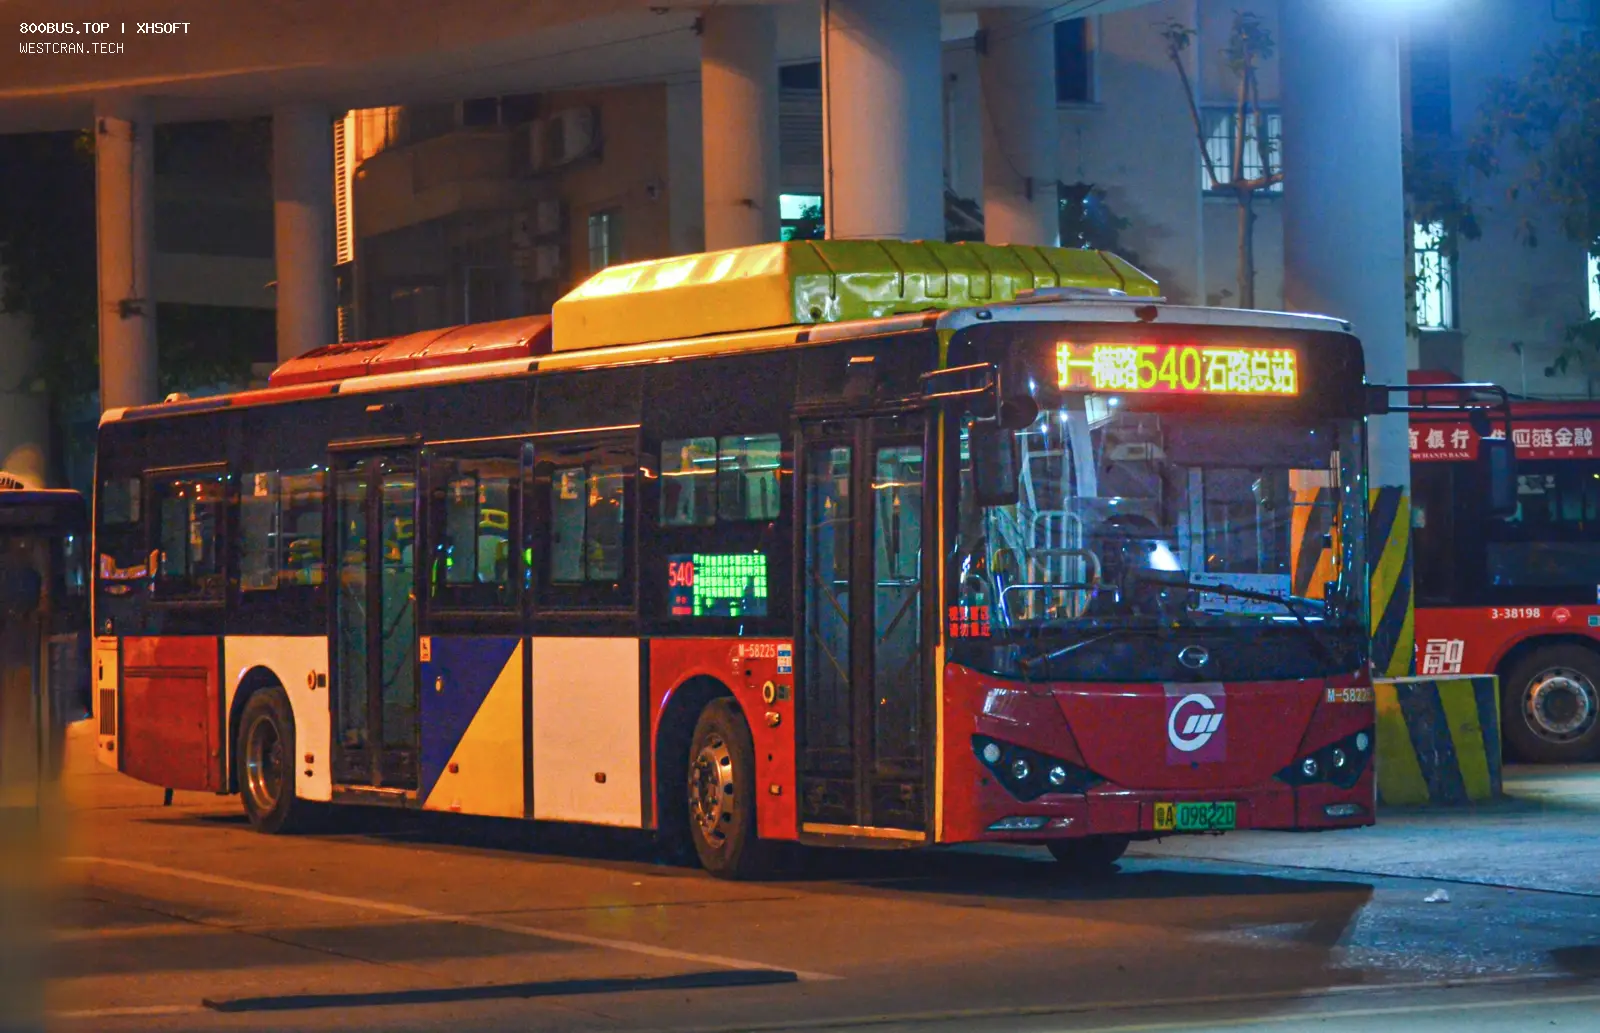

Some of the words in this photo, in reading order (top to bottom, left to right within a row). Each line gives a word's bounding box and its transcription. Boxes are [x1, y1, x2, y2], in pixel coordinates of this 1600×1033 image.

[1138, 346, 1200, 390] 540
[1203, 350, 1293, 392] 石路总站
[668, 561, 694, 588] 540
[1491, 608, 1541, 619] 3-38198
[738, 643, 776, 658] M-58225
[1422, 638, 1465, 674] 融
